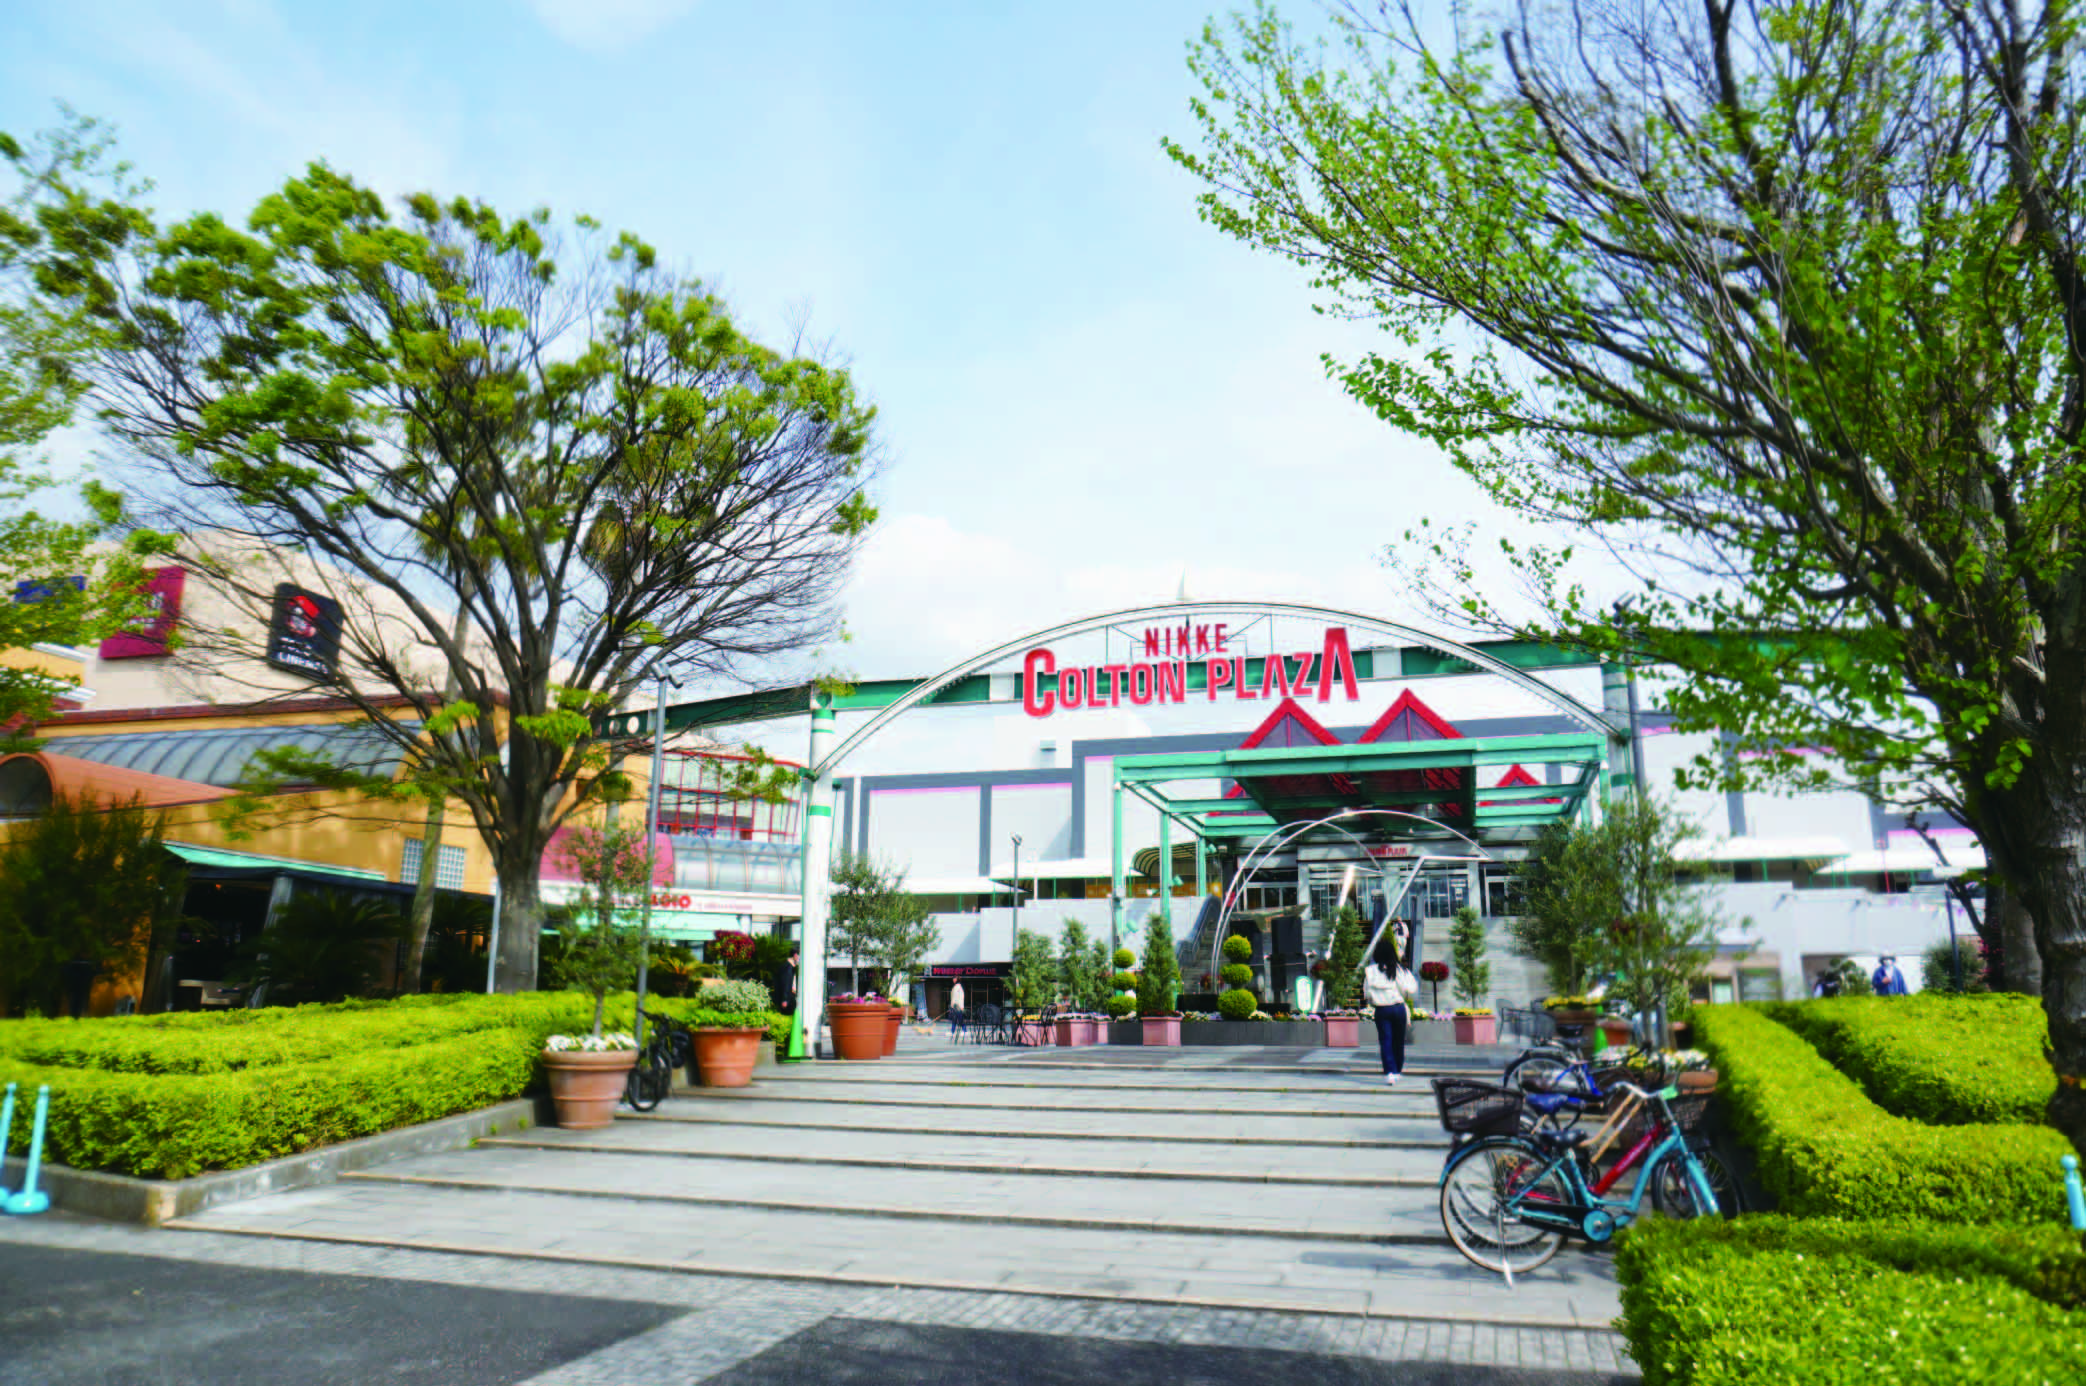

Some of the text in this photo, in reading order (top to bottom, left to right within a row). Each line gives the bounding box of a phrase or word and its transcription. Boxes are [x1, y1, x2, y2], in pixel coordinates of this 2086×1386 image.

[1145, 623, 1228, 657] NIKKE
[1022, 627, 1360, 719] COLTON PLAZA
